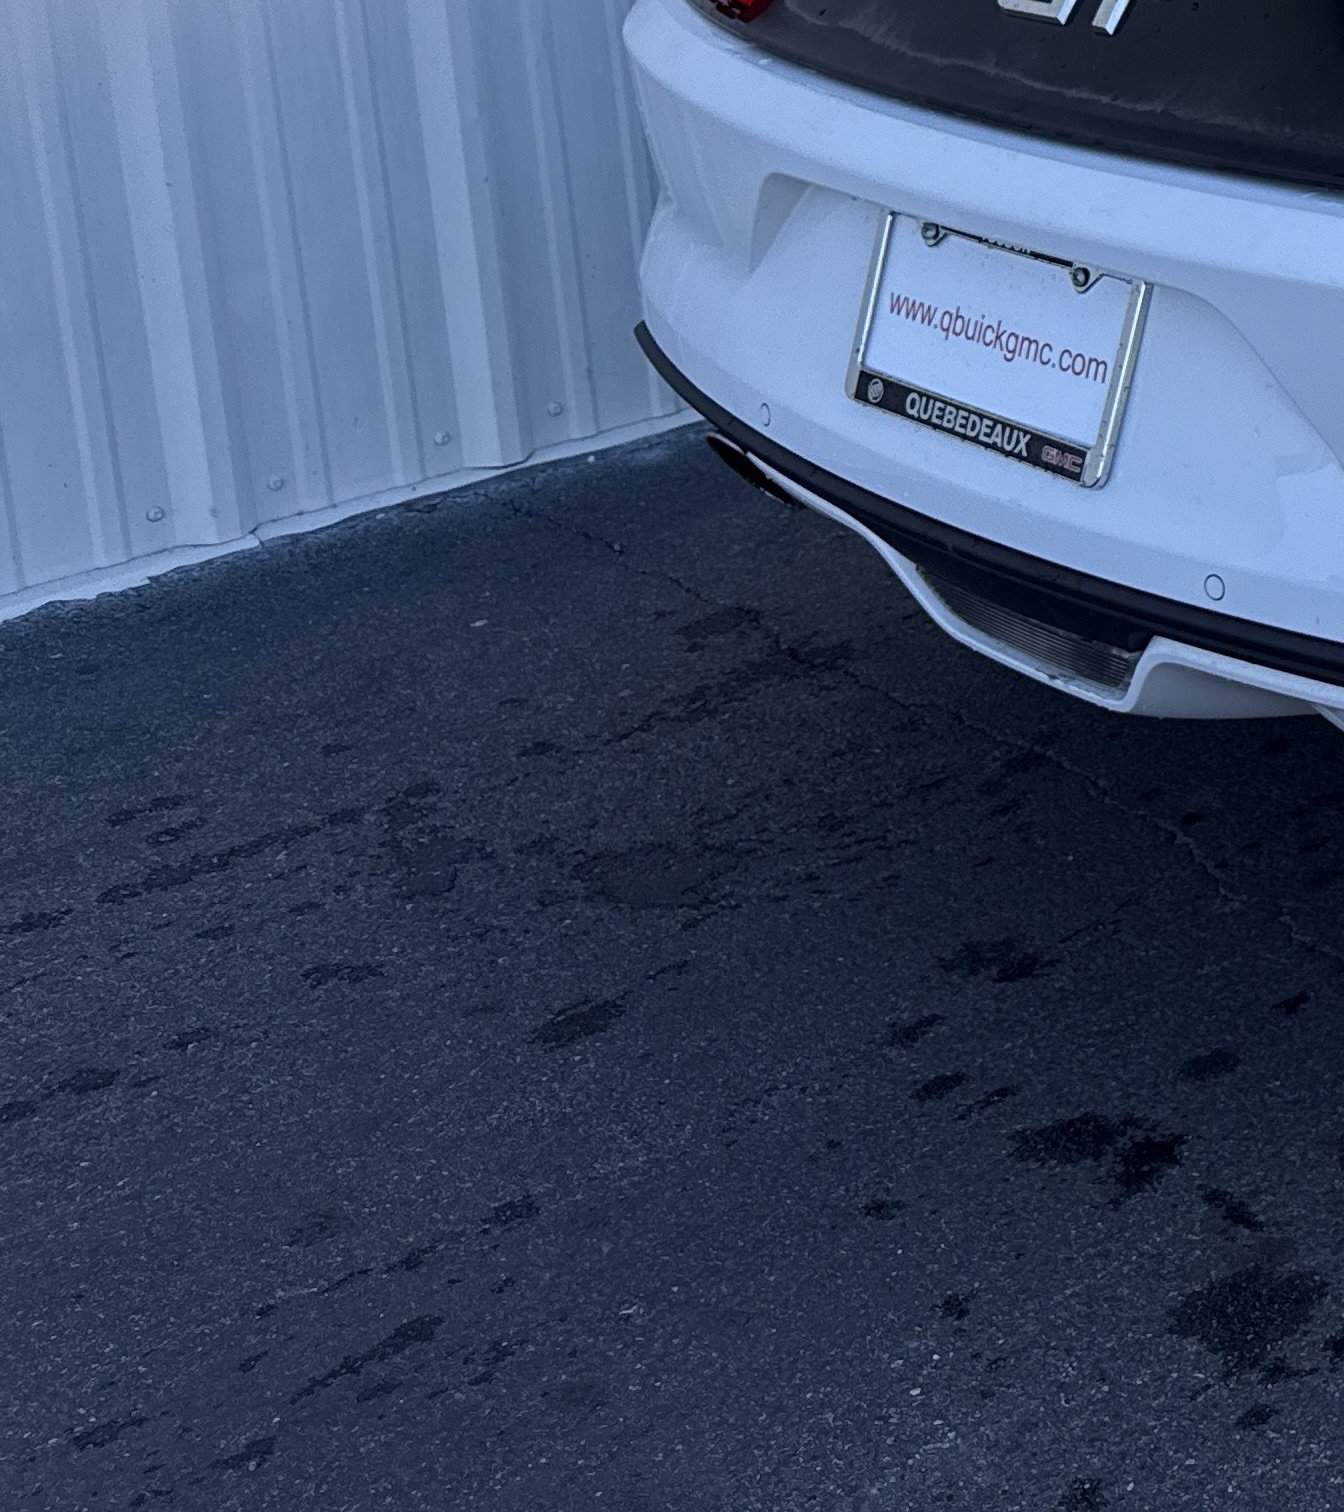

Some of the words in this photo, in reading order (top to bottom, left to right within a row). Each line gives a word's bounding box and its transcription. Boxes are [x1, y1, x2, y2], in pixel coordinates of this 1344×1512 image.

[889, 291, 1108, 384] www.qbuickgmc.com
[905, 391, 1031, 457] QUEBEDEAUX
[1041, 444, 1083, 473] GMC
